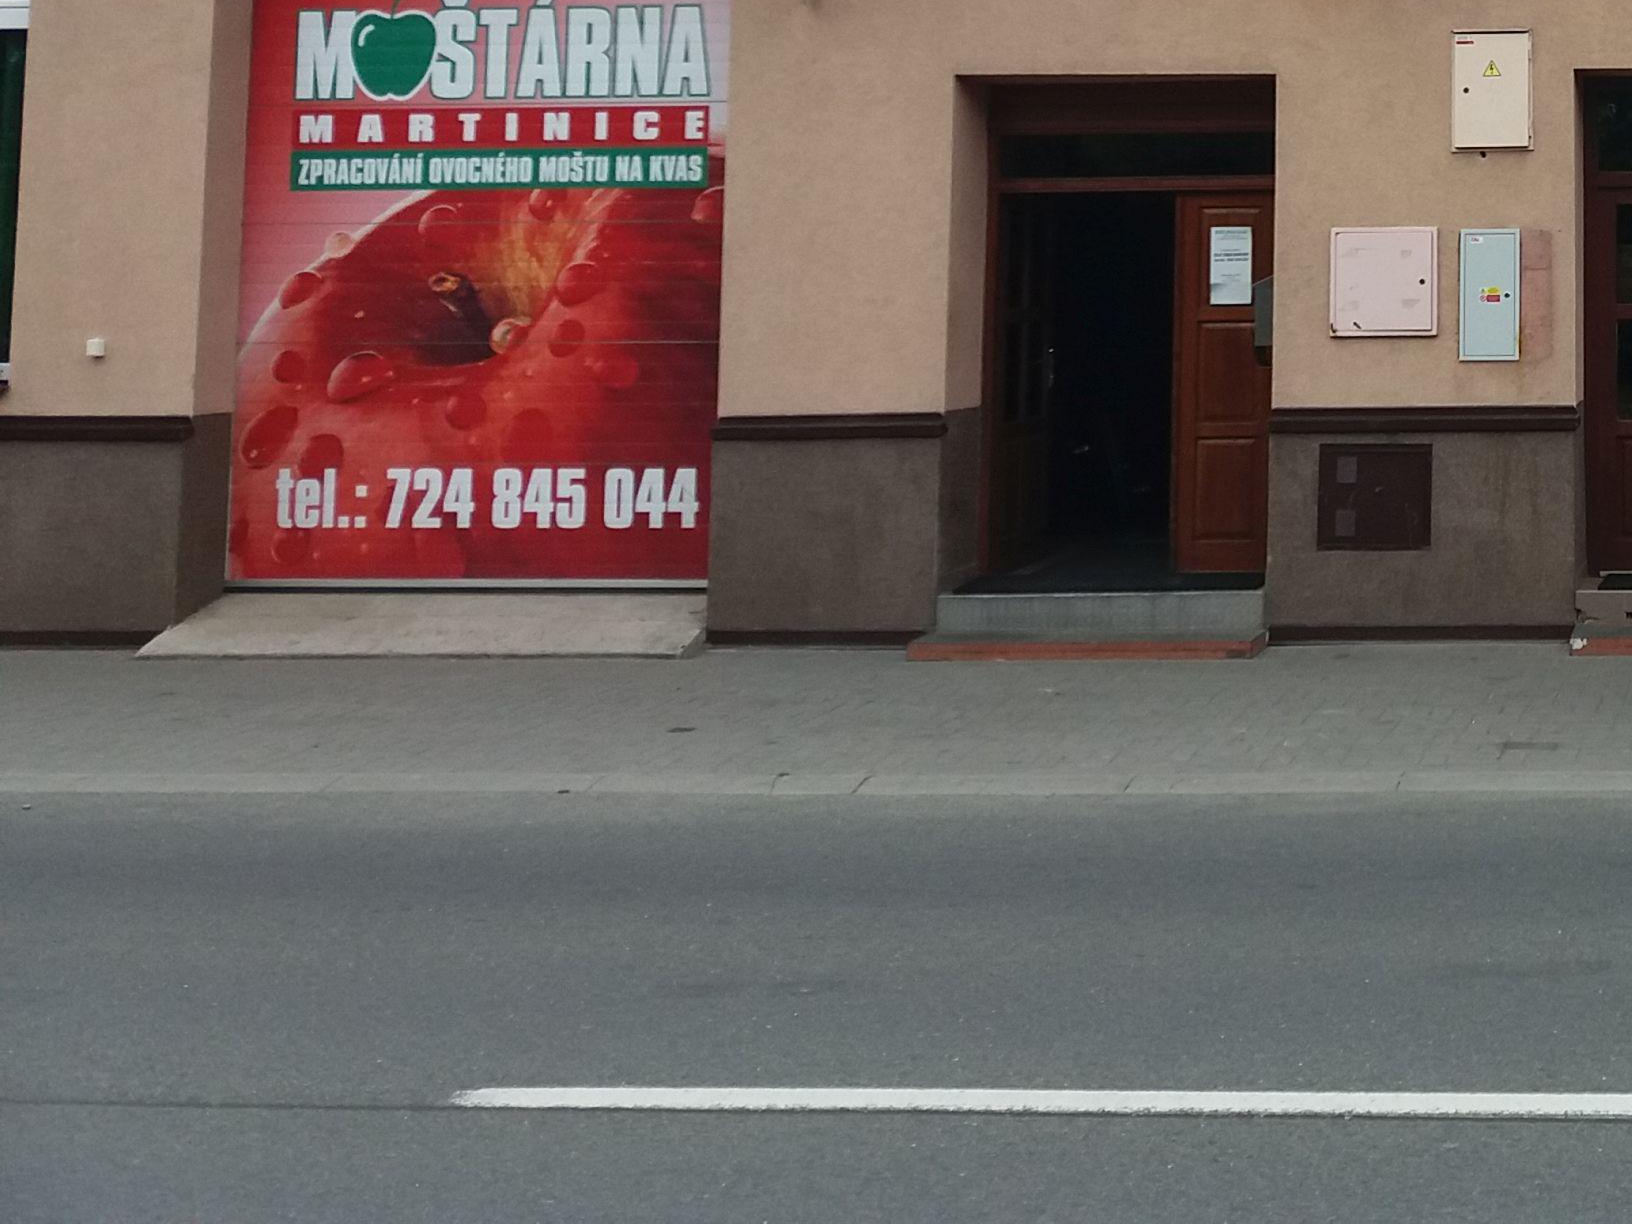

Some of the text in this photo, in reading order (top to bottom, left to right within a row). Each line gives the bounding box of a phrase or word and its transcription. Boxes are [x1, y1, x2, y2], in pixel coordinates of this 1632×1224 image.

[300, 111, 705, 144] MARTINICE
[298, 150, 702, 186] ZPRACOVÁNÍ OVOCNÉHO MOŠTU NA KVAS
[276, 467, 699, 529] tel.: 724 845 044
